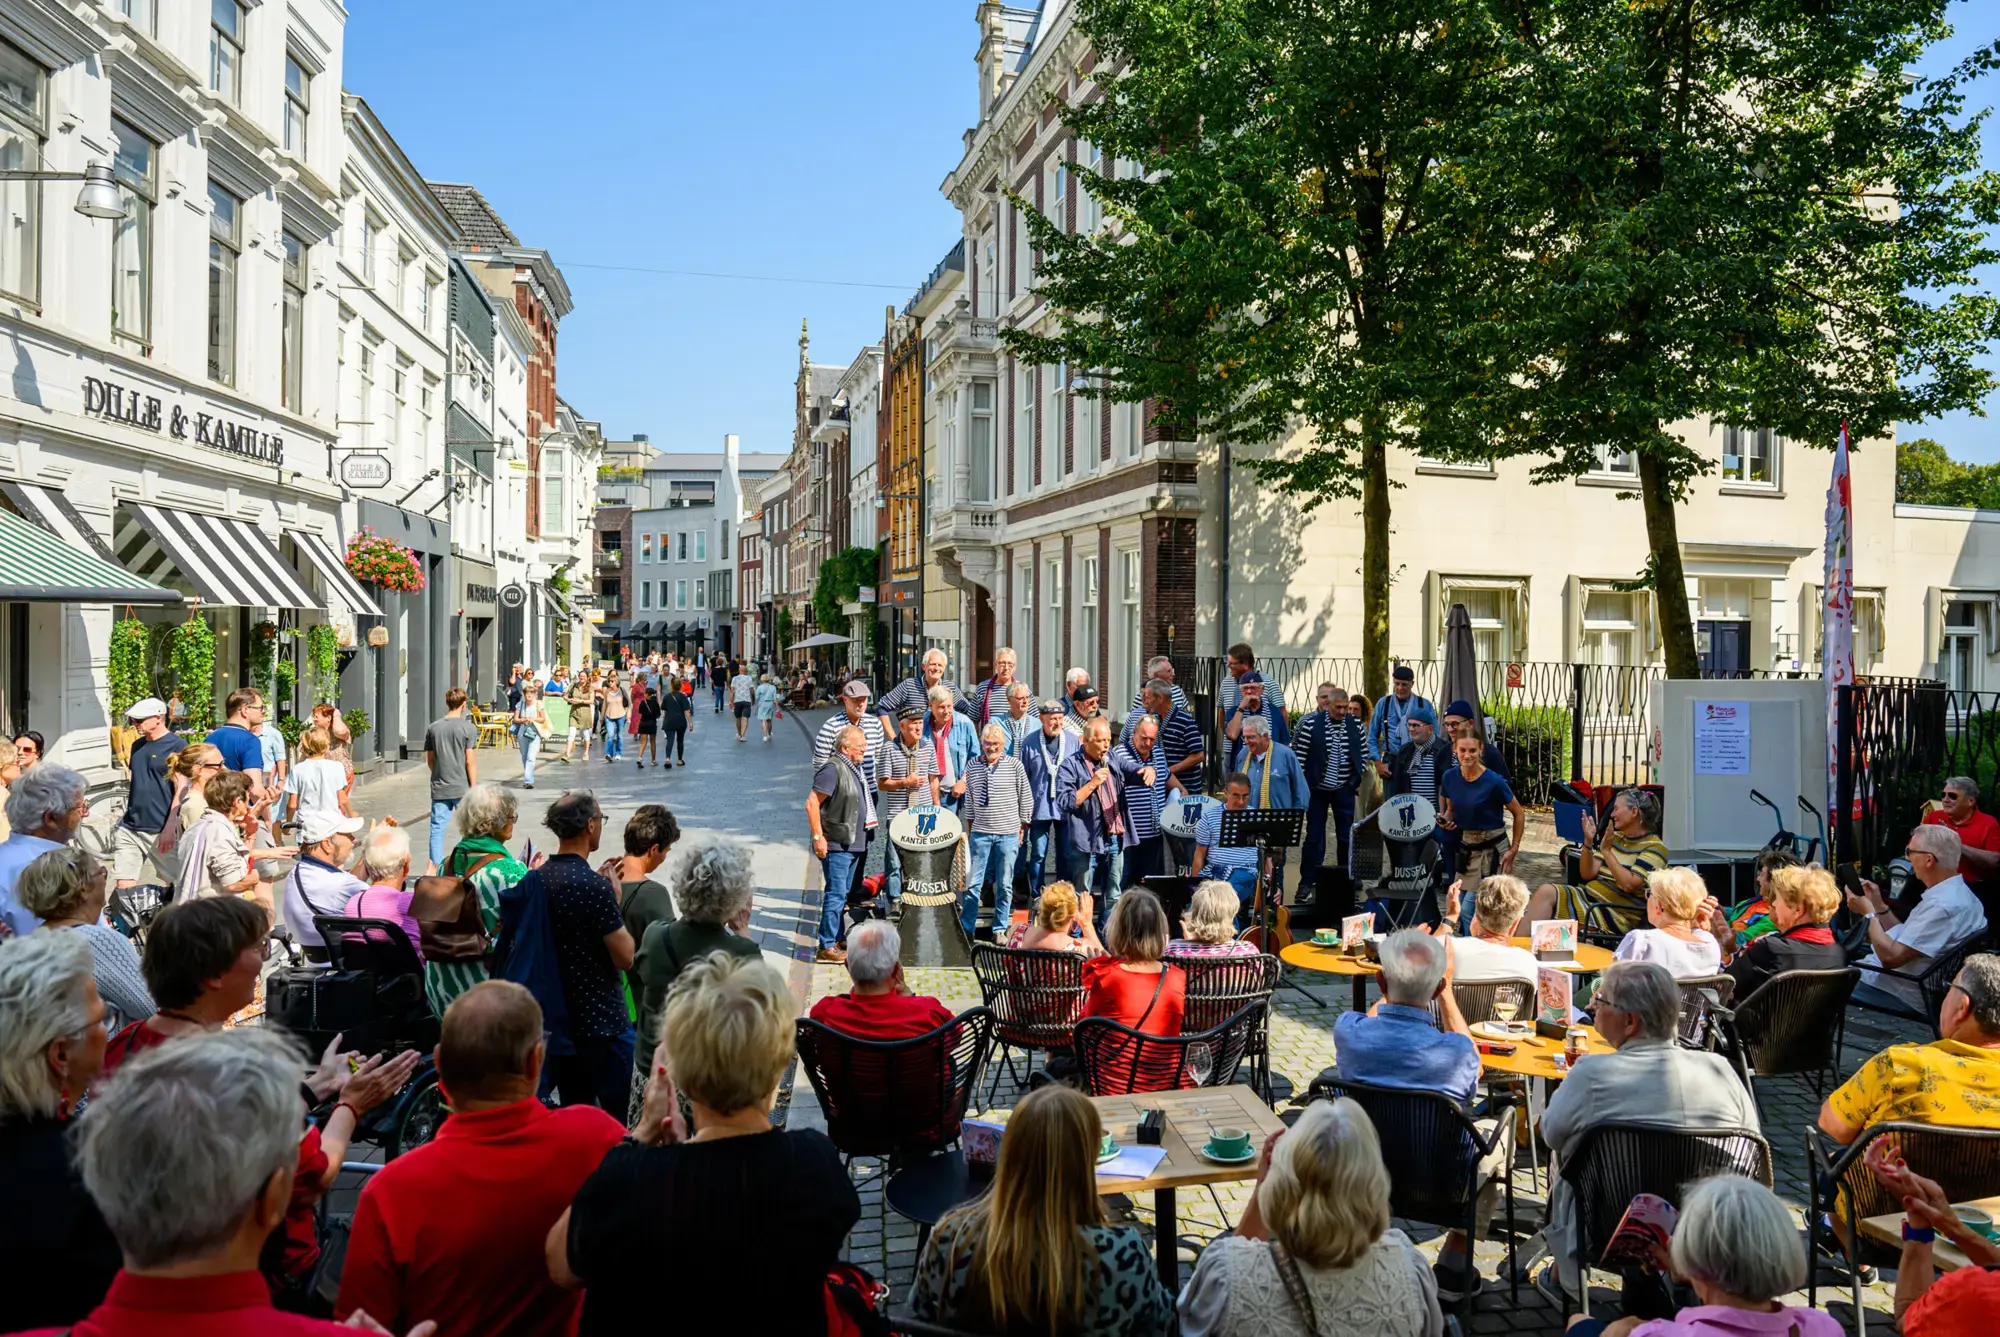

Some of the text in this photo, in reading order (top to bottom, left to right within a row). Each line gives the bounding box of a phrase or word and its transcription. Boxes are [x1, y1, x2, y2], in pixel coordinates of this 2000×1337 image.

[84, 376, 283, 466] DILLE & KAMILLE
[908, 806, 941, 815] MUITERIJ
[1388, 824, 1432, 837] KANTJE BOORD
[900, 832, 954, 845] KANTJE BOORD
[907, 879, 948, 893] DUSSEN
